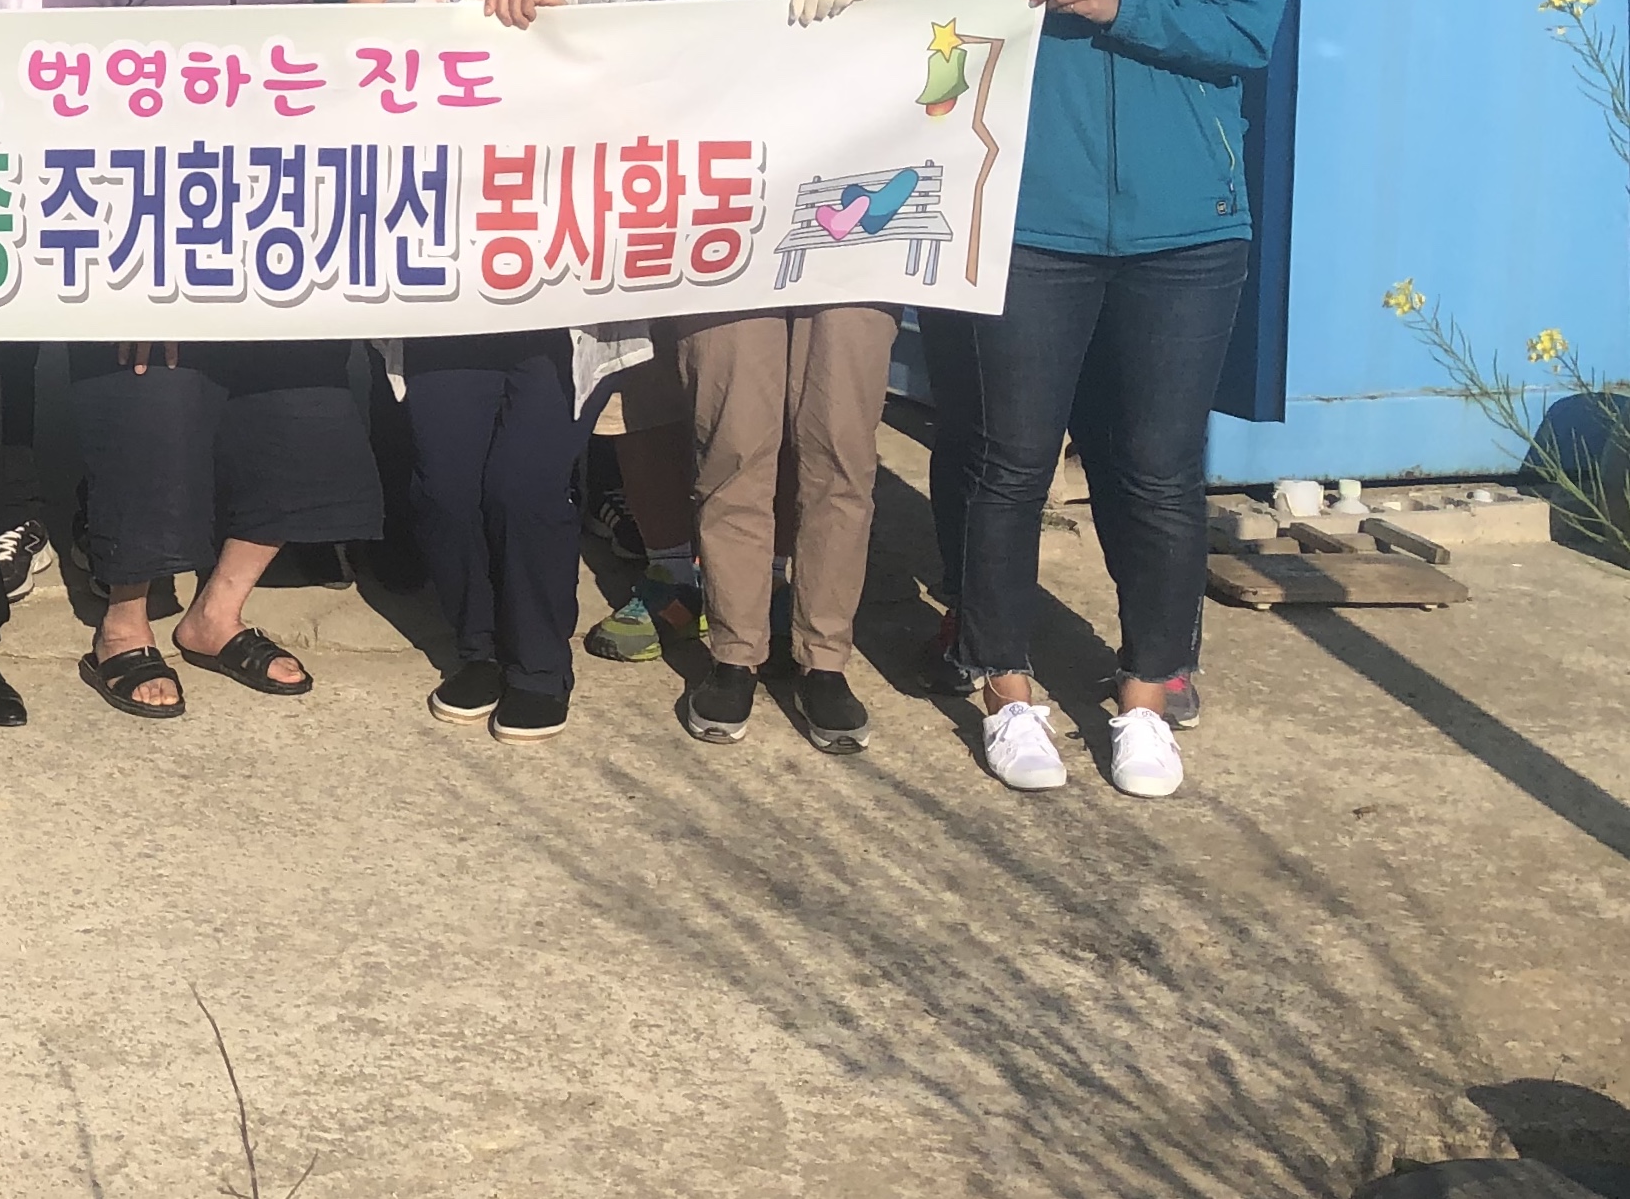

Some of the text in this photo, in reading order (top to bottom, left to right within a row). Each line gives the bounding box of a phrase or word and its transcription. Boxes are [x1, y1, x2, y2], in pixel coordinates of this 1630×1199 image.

[29, 45, 326, 118] 번영하는
[357, 47, 502, 113] 진도
[39, 140, 448, 292] 주거환경개선
[475, 135, 758, 291] 봉사활동
